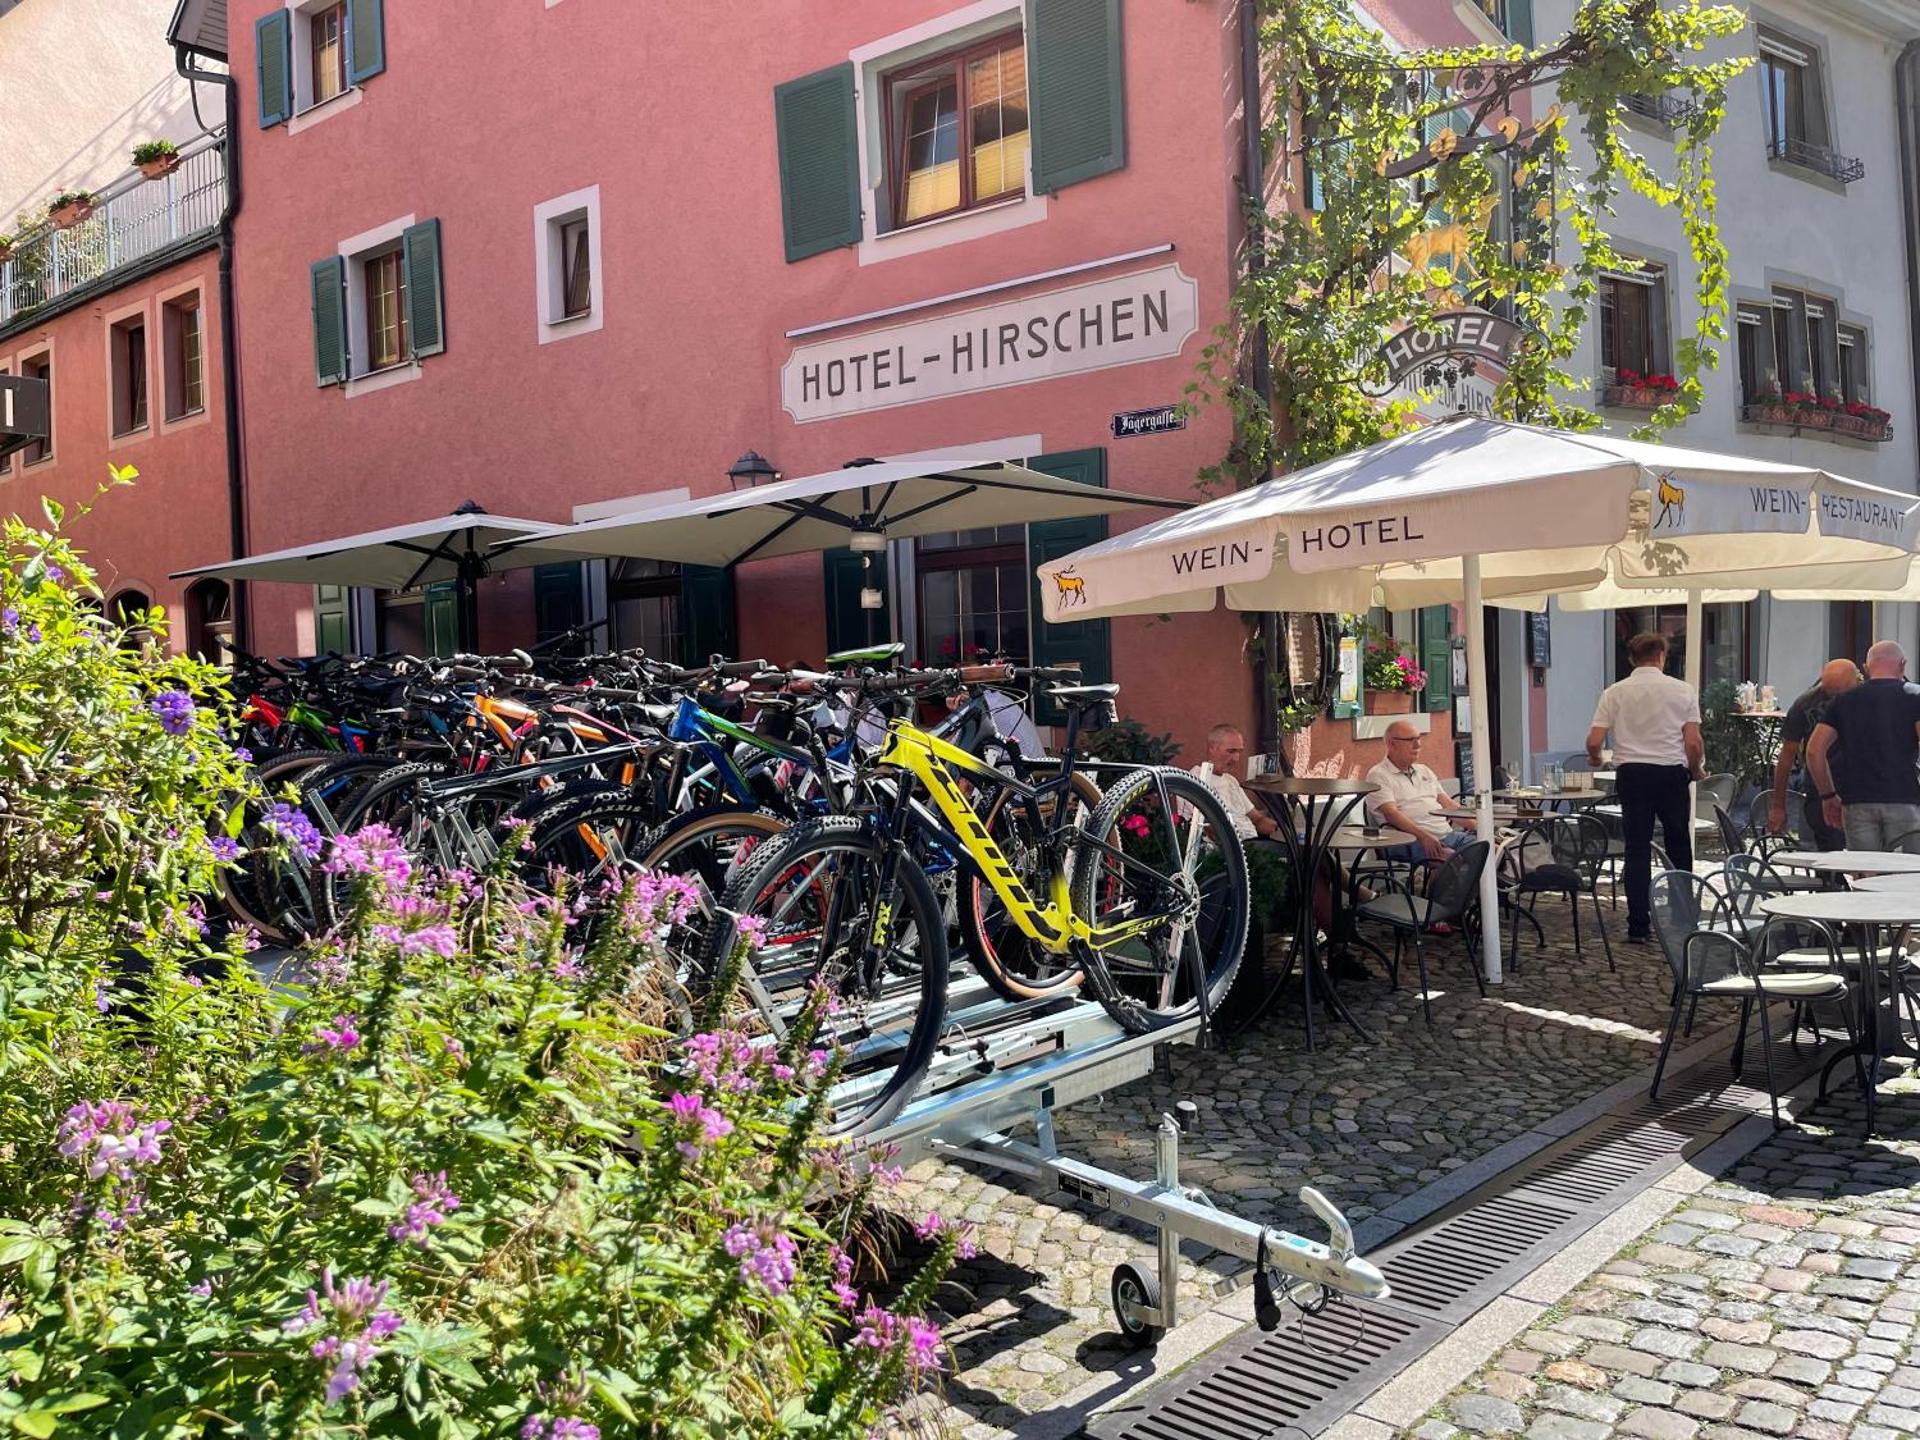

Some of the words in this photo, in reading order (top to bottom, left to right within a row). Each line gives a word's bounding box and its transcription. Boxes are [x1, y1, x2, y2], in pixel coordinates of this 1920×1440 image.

[1385, 316, 1500, 370] HOTEL
[1749, 487, 1807, 515] WEIN-
[1821, 494, 1906, 533] RESTAURANT
[1172, 540, 1264, 575] WEIN-
[1301, 515, 1425, 554] HOTEL
[579, 803, 643, 820] MAXXIS
[1126, 914, 1170, 935] SCOTT
